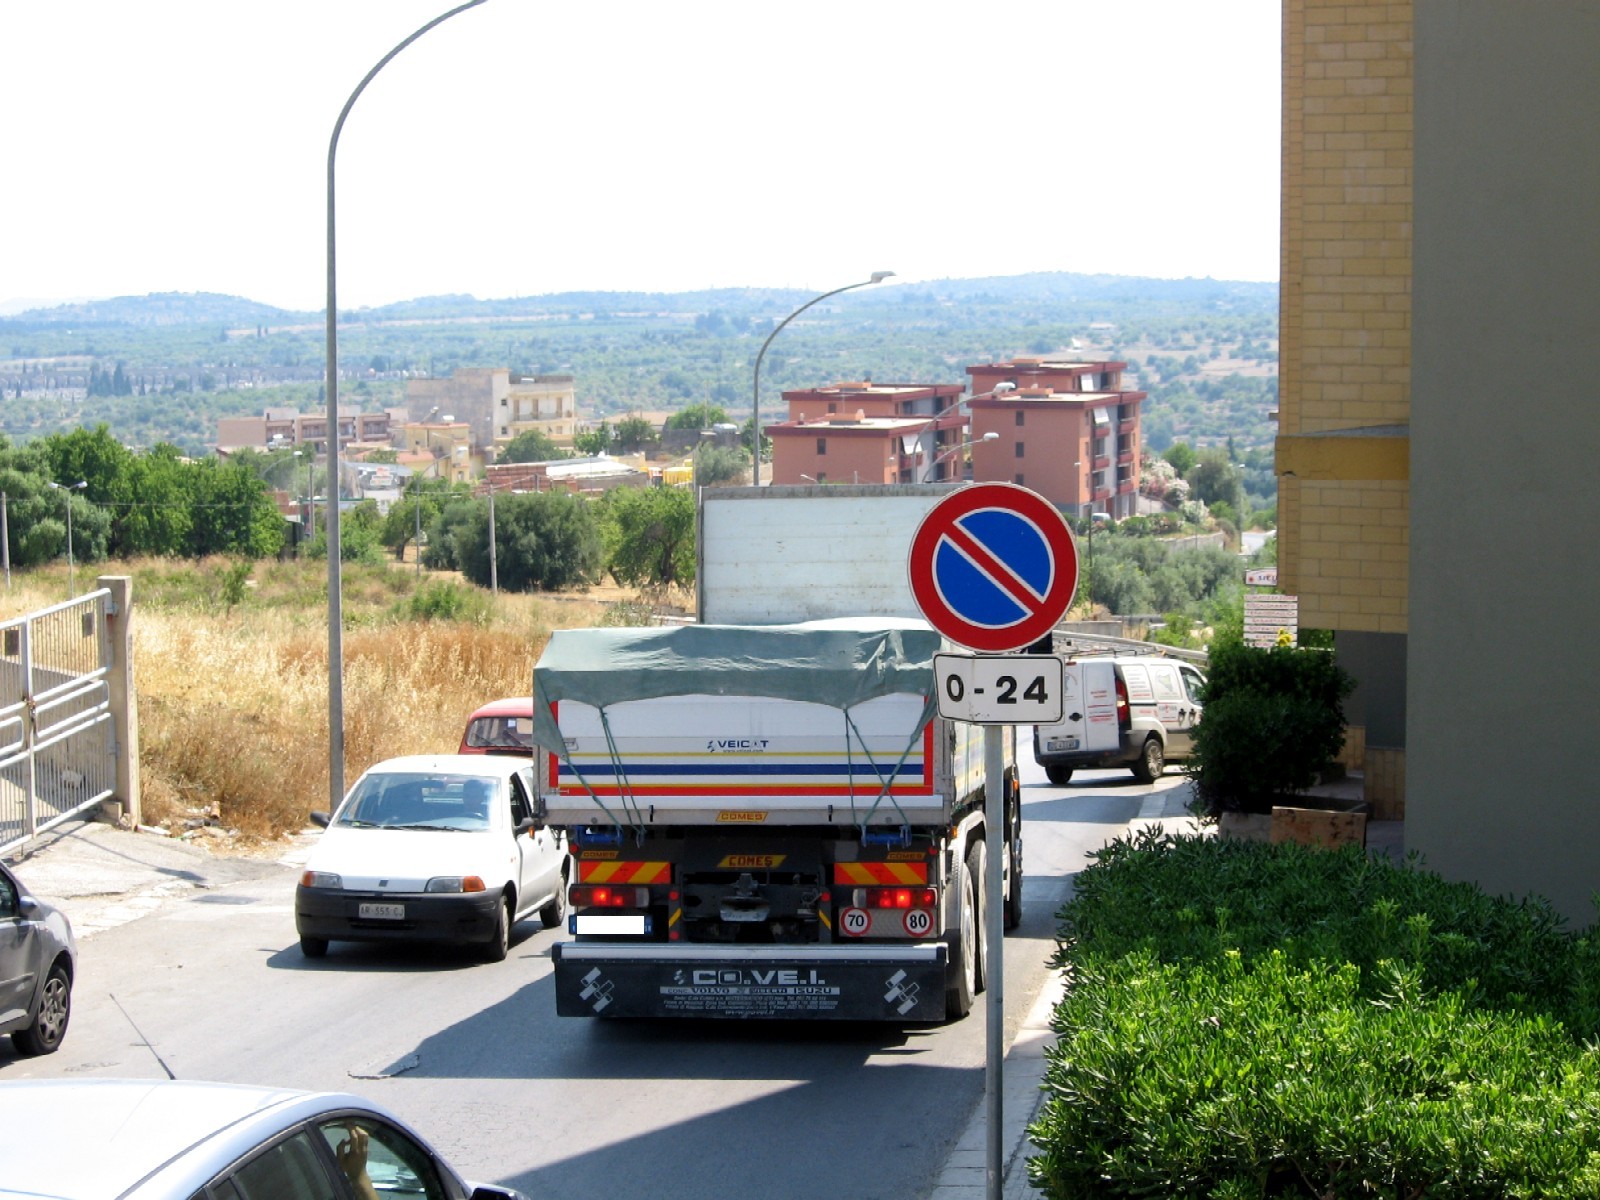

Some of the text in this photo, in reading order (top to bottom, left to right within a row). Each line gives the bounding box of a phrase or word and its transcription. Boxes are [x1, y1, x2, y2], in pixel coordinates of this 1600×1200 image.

[721, 812, 763, 820] COMES
[728, 855, 774, 867] COMES
[847, 914, 865, 927] 70
[909, 914, 928, 928] 80
